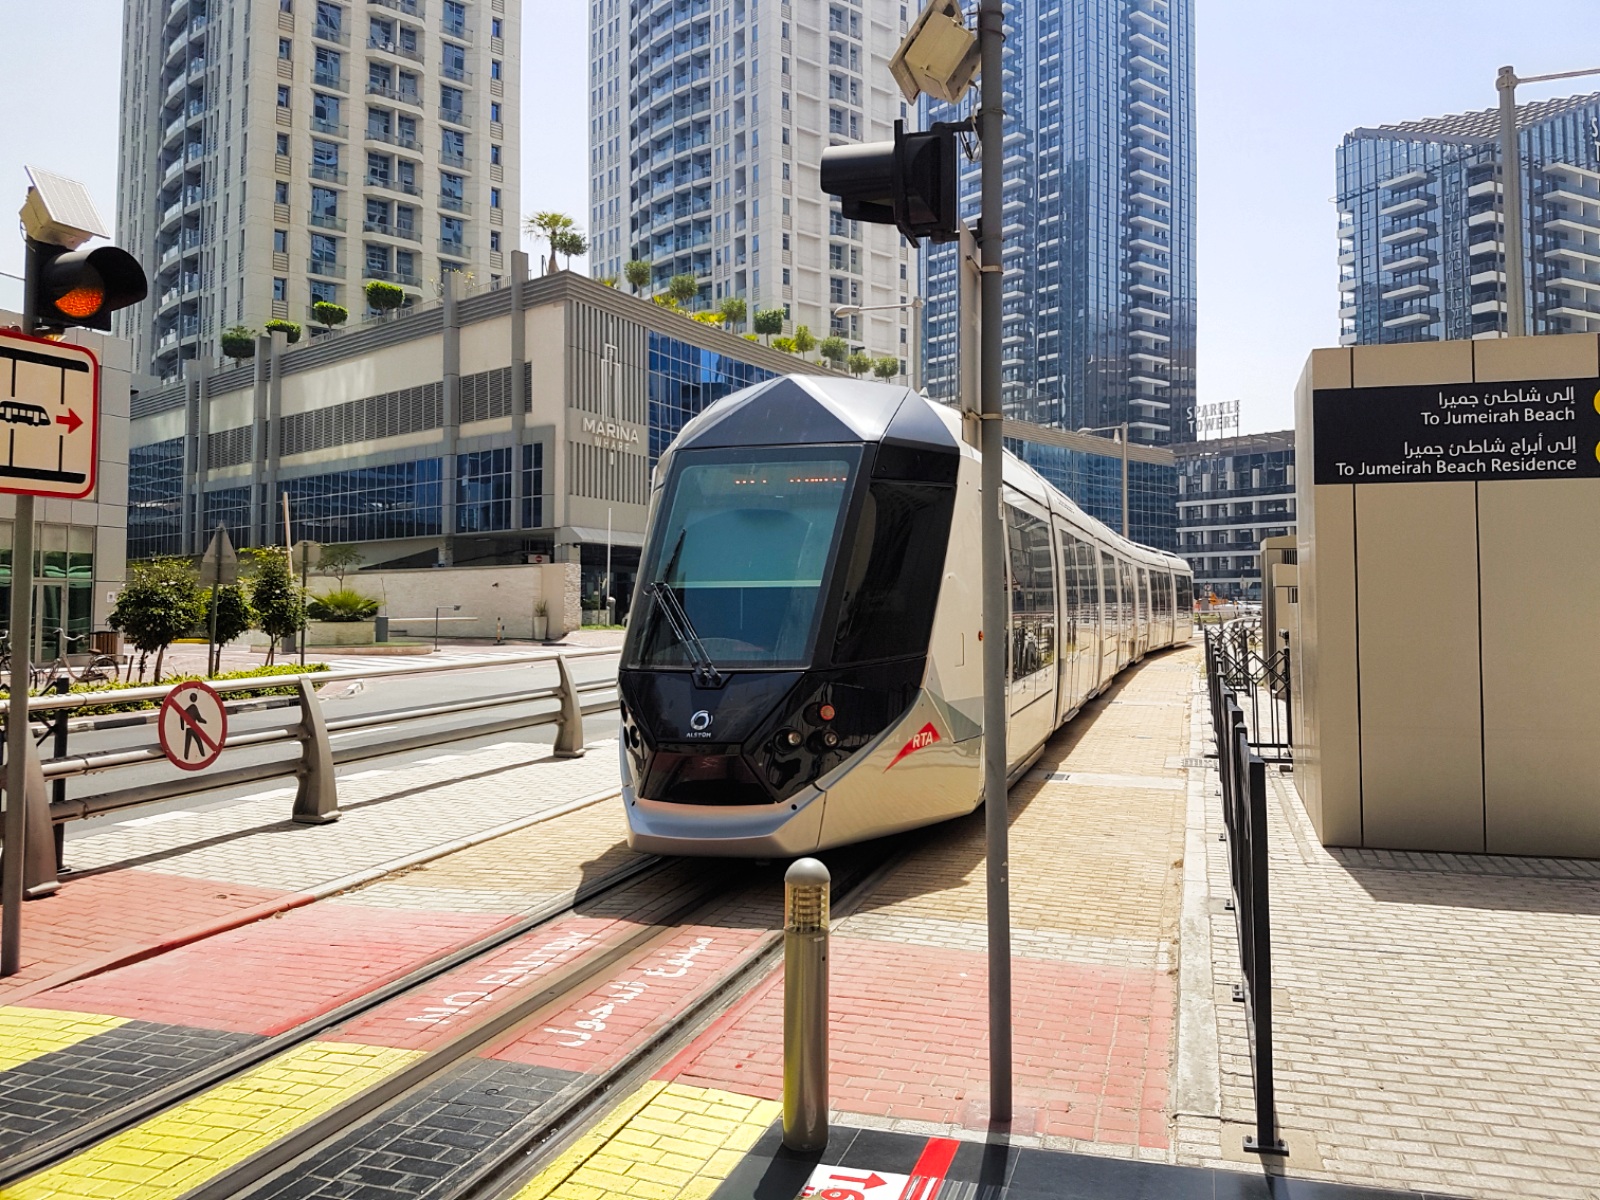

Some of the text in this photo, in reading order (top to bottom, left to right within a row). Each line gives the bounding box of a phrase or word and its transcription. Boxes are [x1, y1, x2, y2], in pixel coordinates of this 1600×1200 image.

[1438, 386, 1576, 409] إلى شاطئ جميرا
[1187, 400, 1240, 419] SPARKLE
[1420, 407, 1576, 426] To Jumeirah Beach
[583, 418, 638, 443] MARINA
[1188, 415, 1239, 433] TOWERS
[595, 437, 630, 450] WHARF
[1404, 433, 1577, 459] إلى أبراج شاطئ جميرا
[1335, 456, 1577, 476] To Jumeirah Beach Residence
[912, 731, 934, 749] RTA
[405, 930, 603, 1025] NO ENTRY
[543, 937, 714, 1047] ممنوع الدخول
